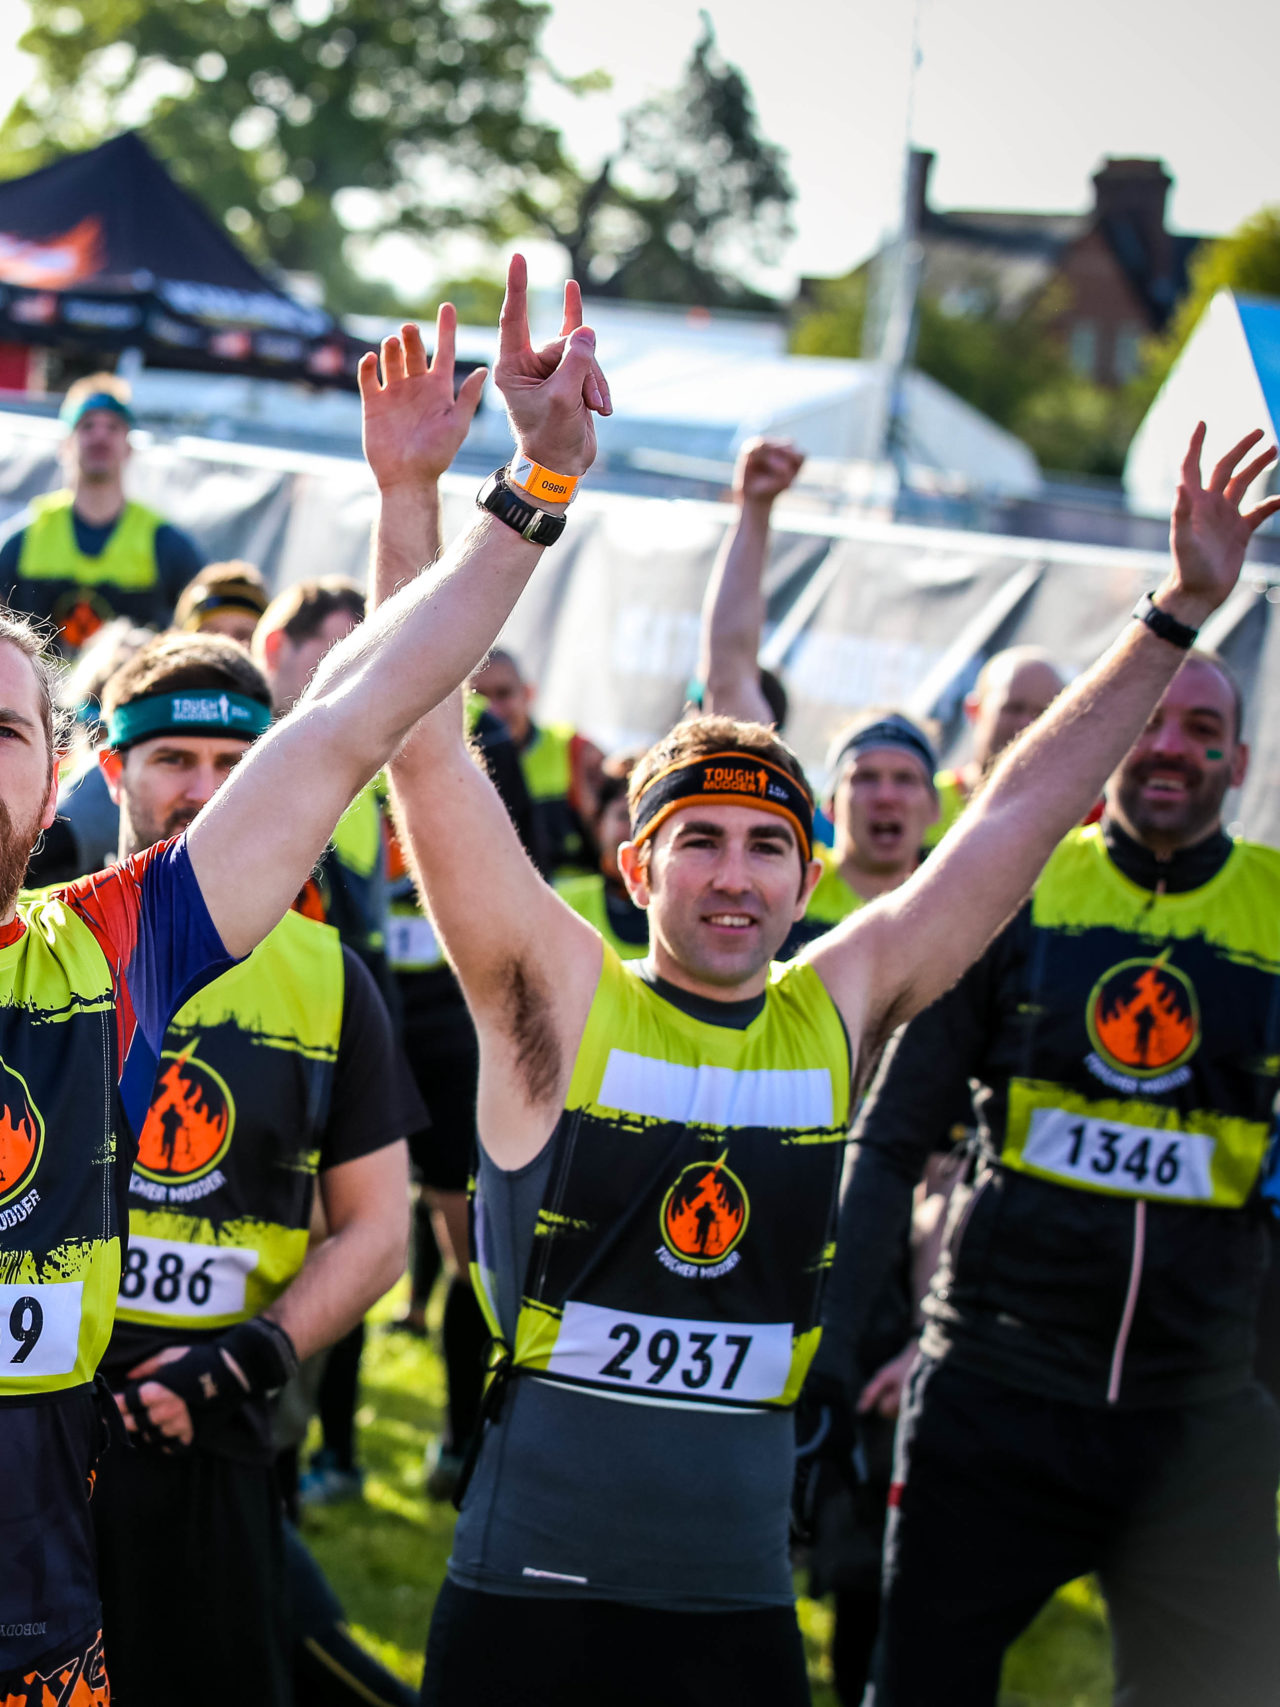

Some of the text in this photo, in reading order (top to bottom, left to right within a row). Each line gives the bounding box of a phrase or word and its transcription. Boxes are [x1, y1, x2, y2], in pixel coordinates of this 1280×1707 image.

[541, 480, 568, 494] 16860
[174, 699, 218, 712] TOUGH
[704, 768, 755, 781] TOUGH
[703, 780, 757, 792] MUDDER
[1067, 1123, 1181, 1186] 1346
[654, 1245, 698, 1278] TOUGHER
[599, 1323, 753, 1390] 2937
